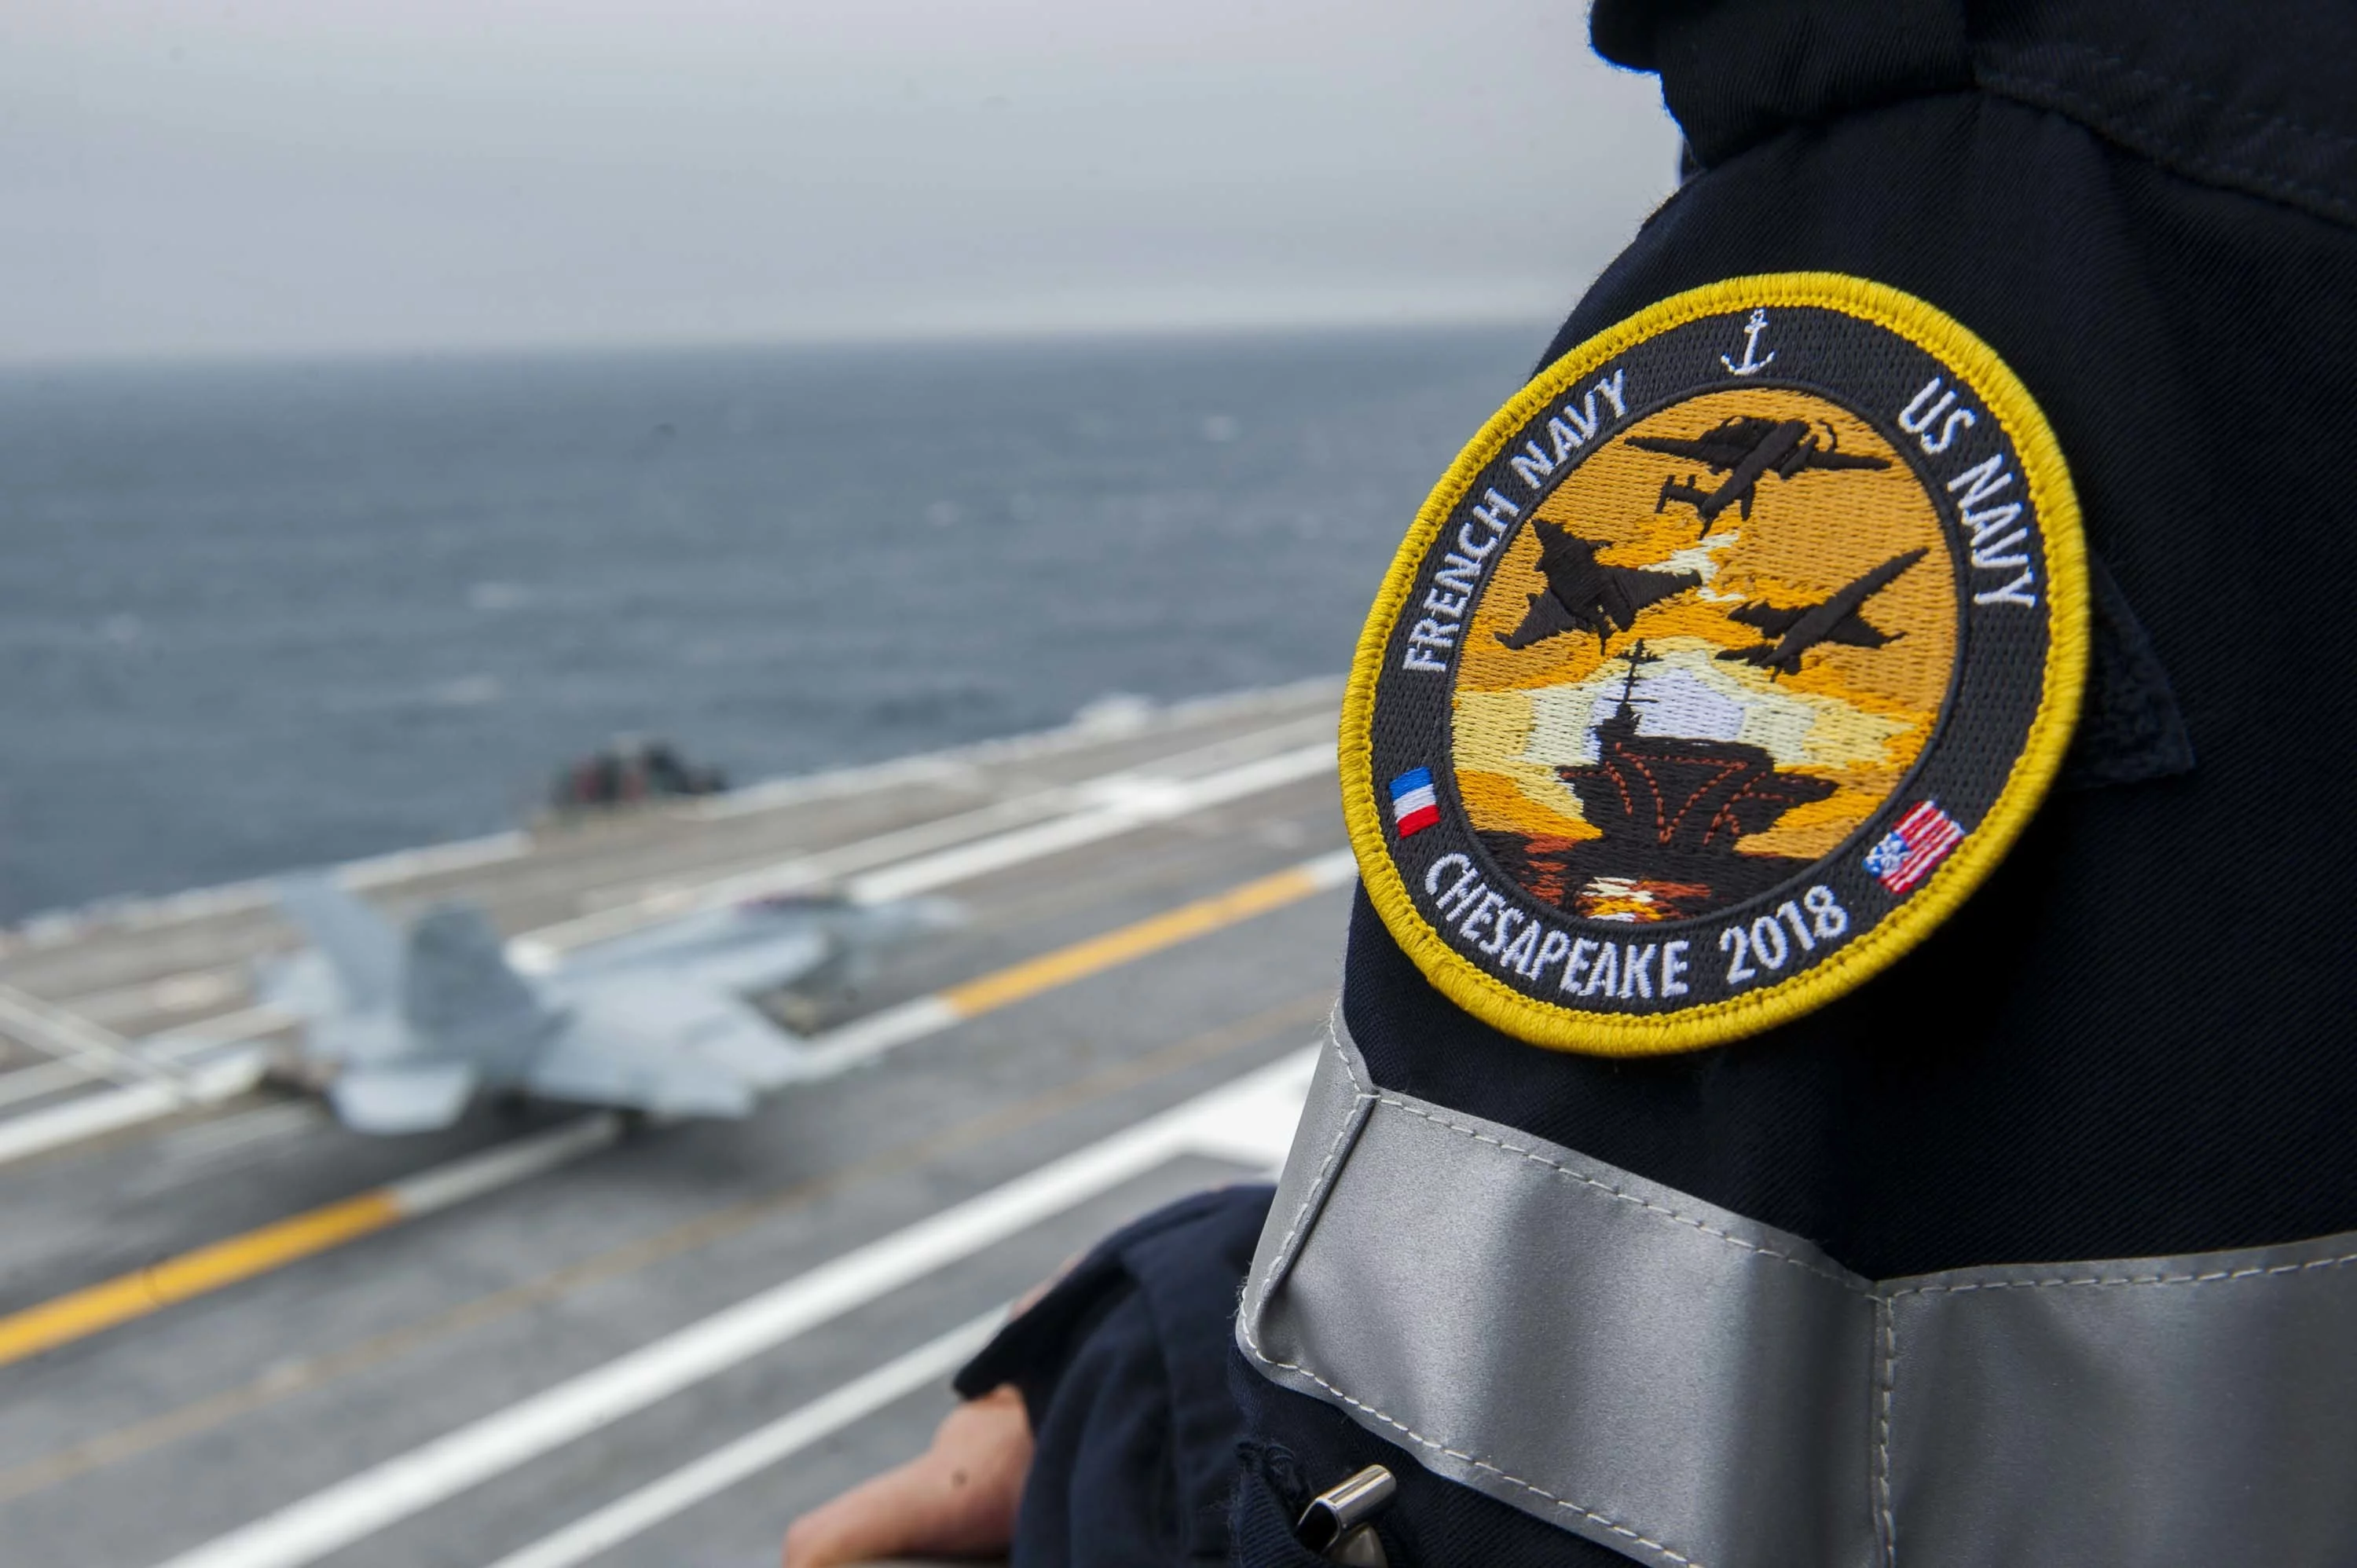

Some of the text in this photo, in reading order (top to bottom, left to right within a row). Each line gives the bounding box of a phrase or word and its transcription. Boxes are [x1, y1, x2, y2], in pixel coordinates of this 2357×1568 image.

[1402, 368, 1632, 673] FRENCH NAVY
[1897, 377, 2036, 610] US NAVY
[1424, 852, 1849, 998] CHESAPEAKE 2018
